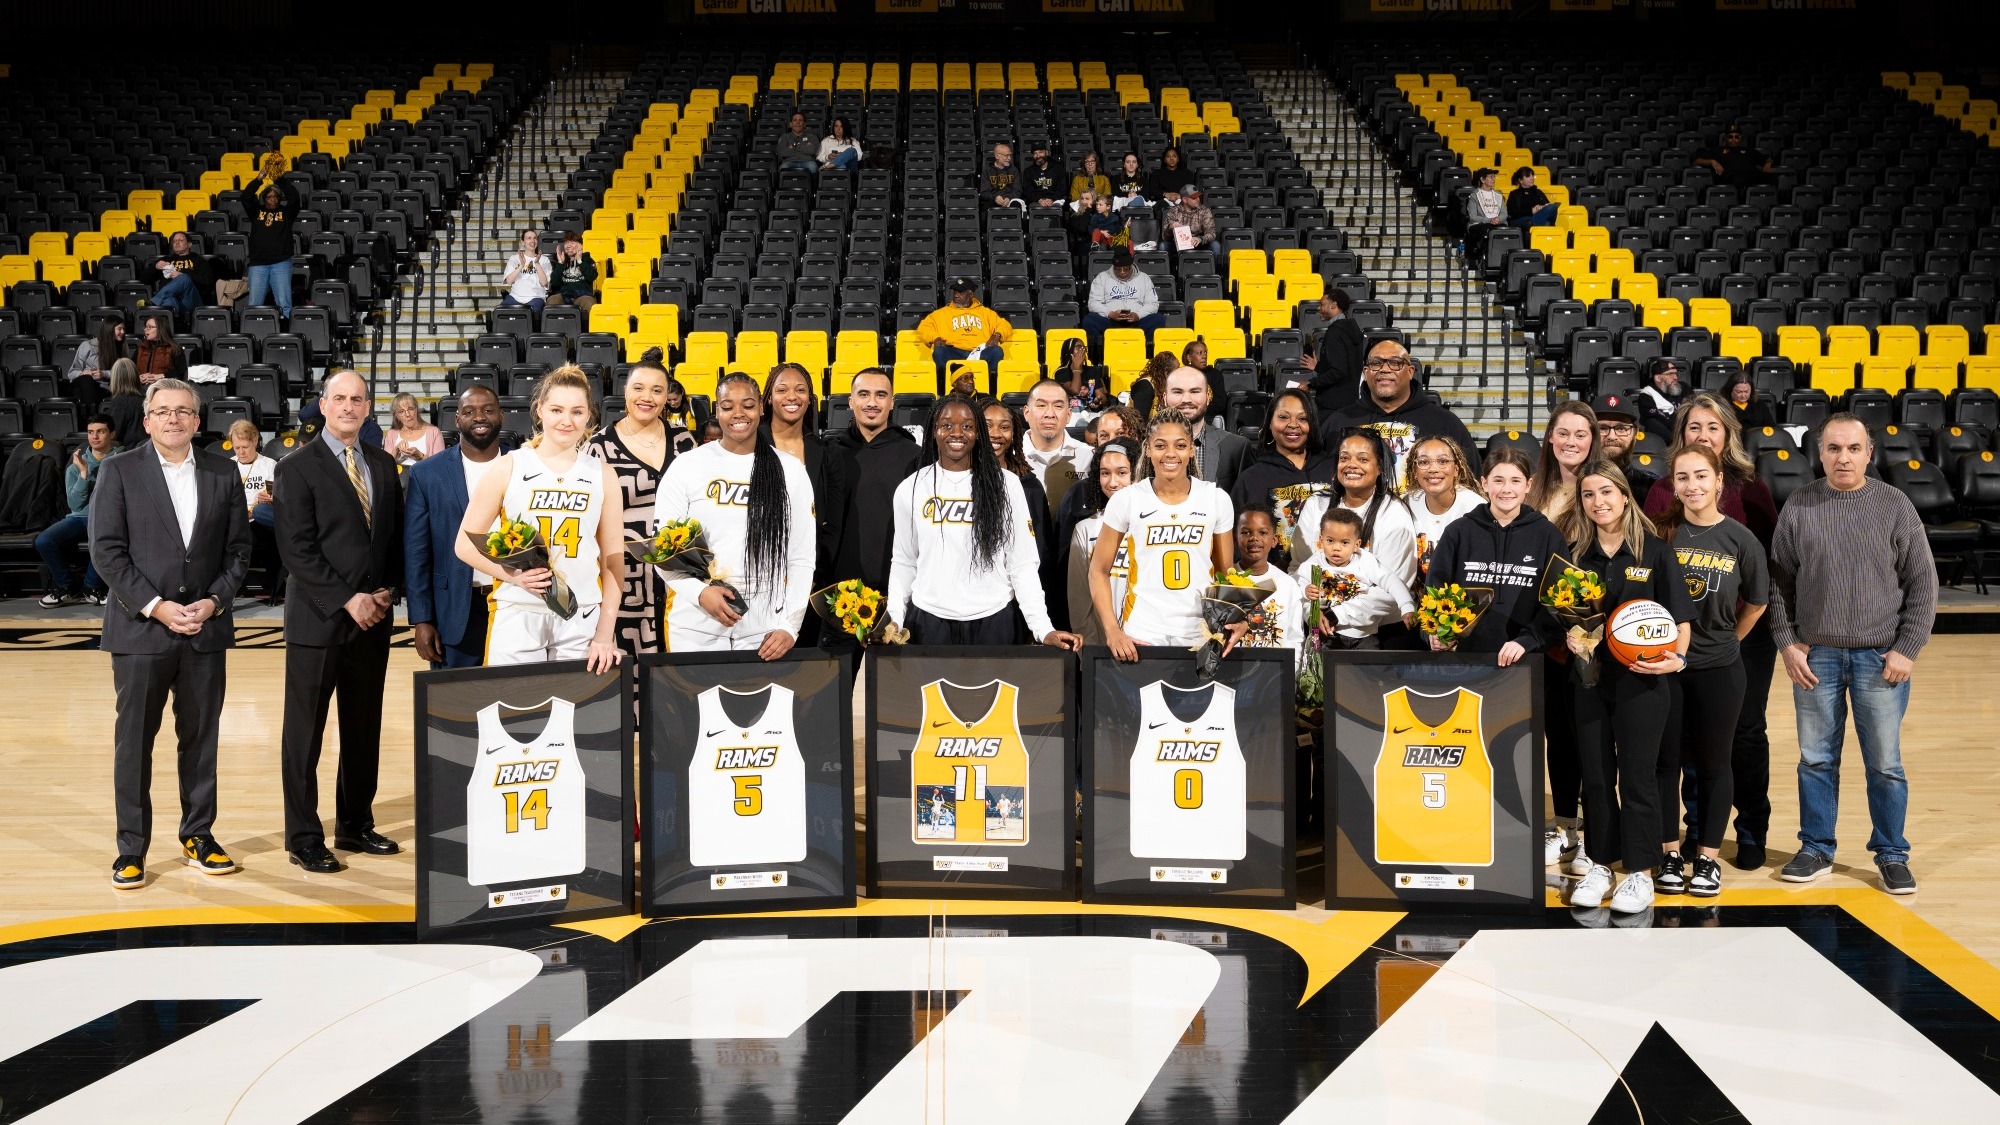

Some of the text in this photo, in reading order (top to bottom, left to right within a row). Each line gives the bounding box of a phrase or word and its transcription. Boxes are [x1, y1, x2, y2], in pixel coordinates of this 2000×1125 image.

[951, 313, 982, 331] RAMS
[530, 490, 590, 514] RAMS
[707, 479, 751, 505] VC
[536, 516, 582, 558] 14
[1146, 524, 1205, 547] RAMS
[1162, 550, 1191, 591] 0
[1625, 566, 1652, 578] VCU
[1688, 549, 1737, 573] RAMS
[1465, 572, 1534, 588] BASKETBALL
[1637, 624, 1670, 640] VCU
[714, 745, 781, 771] RAMS
[934, 737, 1003, 758] RAMS
[1156, 740, 1222, 763] RAMS
[1402, 744, 1467, 768] RAMS
[493, 760, 561, 788] RAMS
[952, 764, 988, 802] 11
[730, 774, 763, 817] 5
[1174, 768, 1203, 810] 0
[1421, 772, 1447, 809] 5
[502, 788, 552, 834] 14
